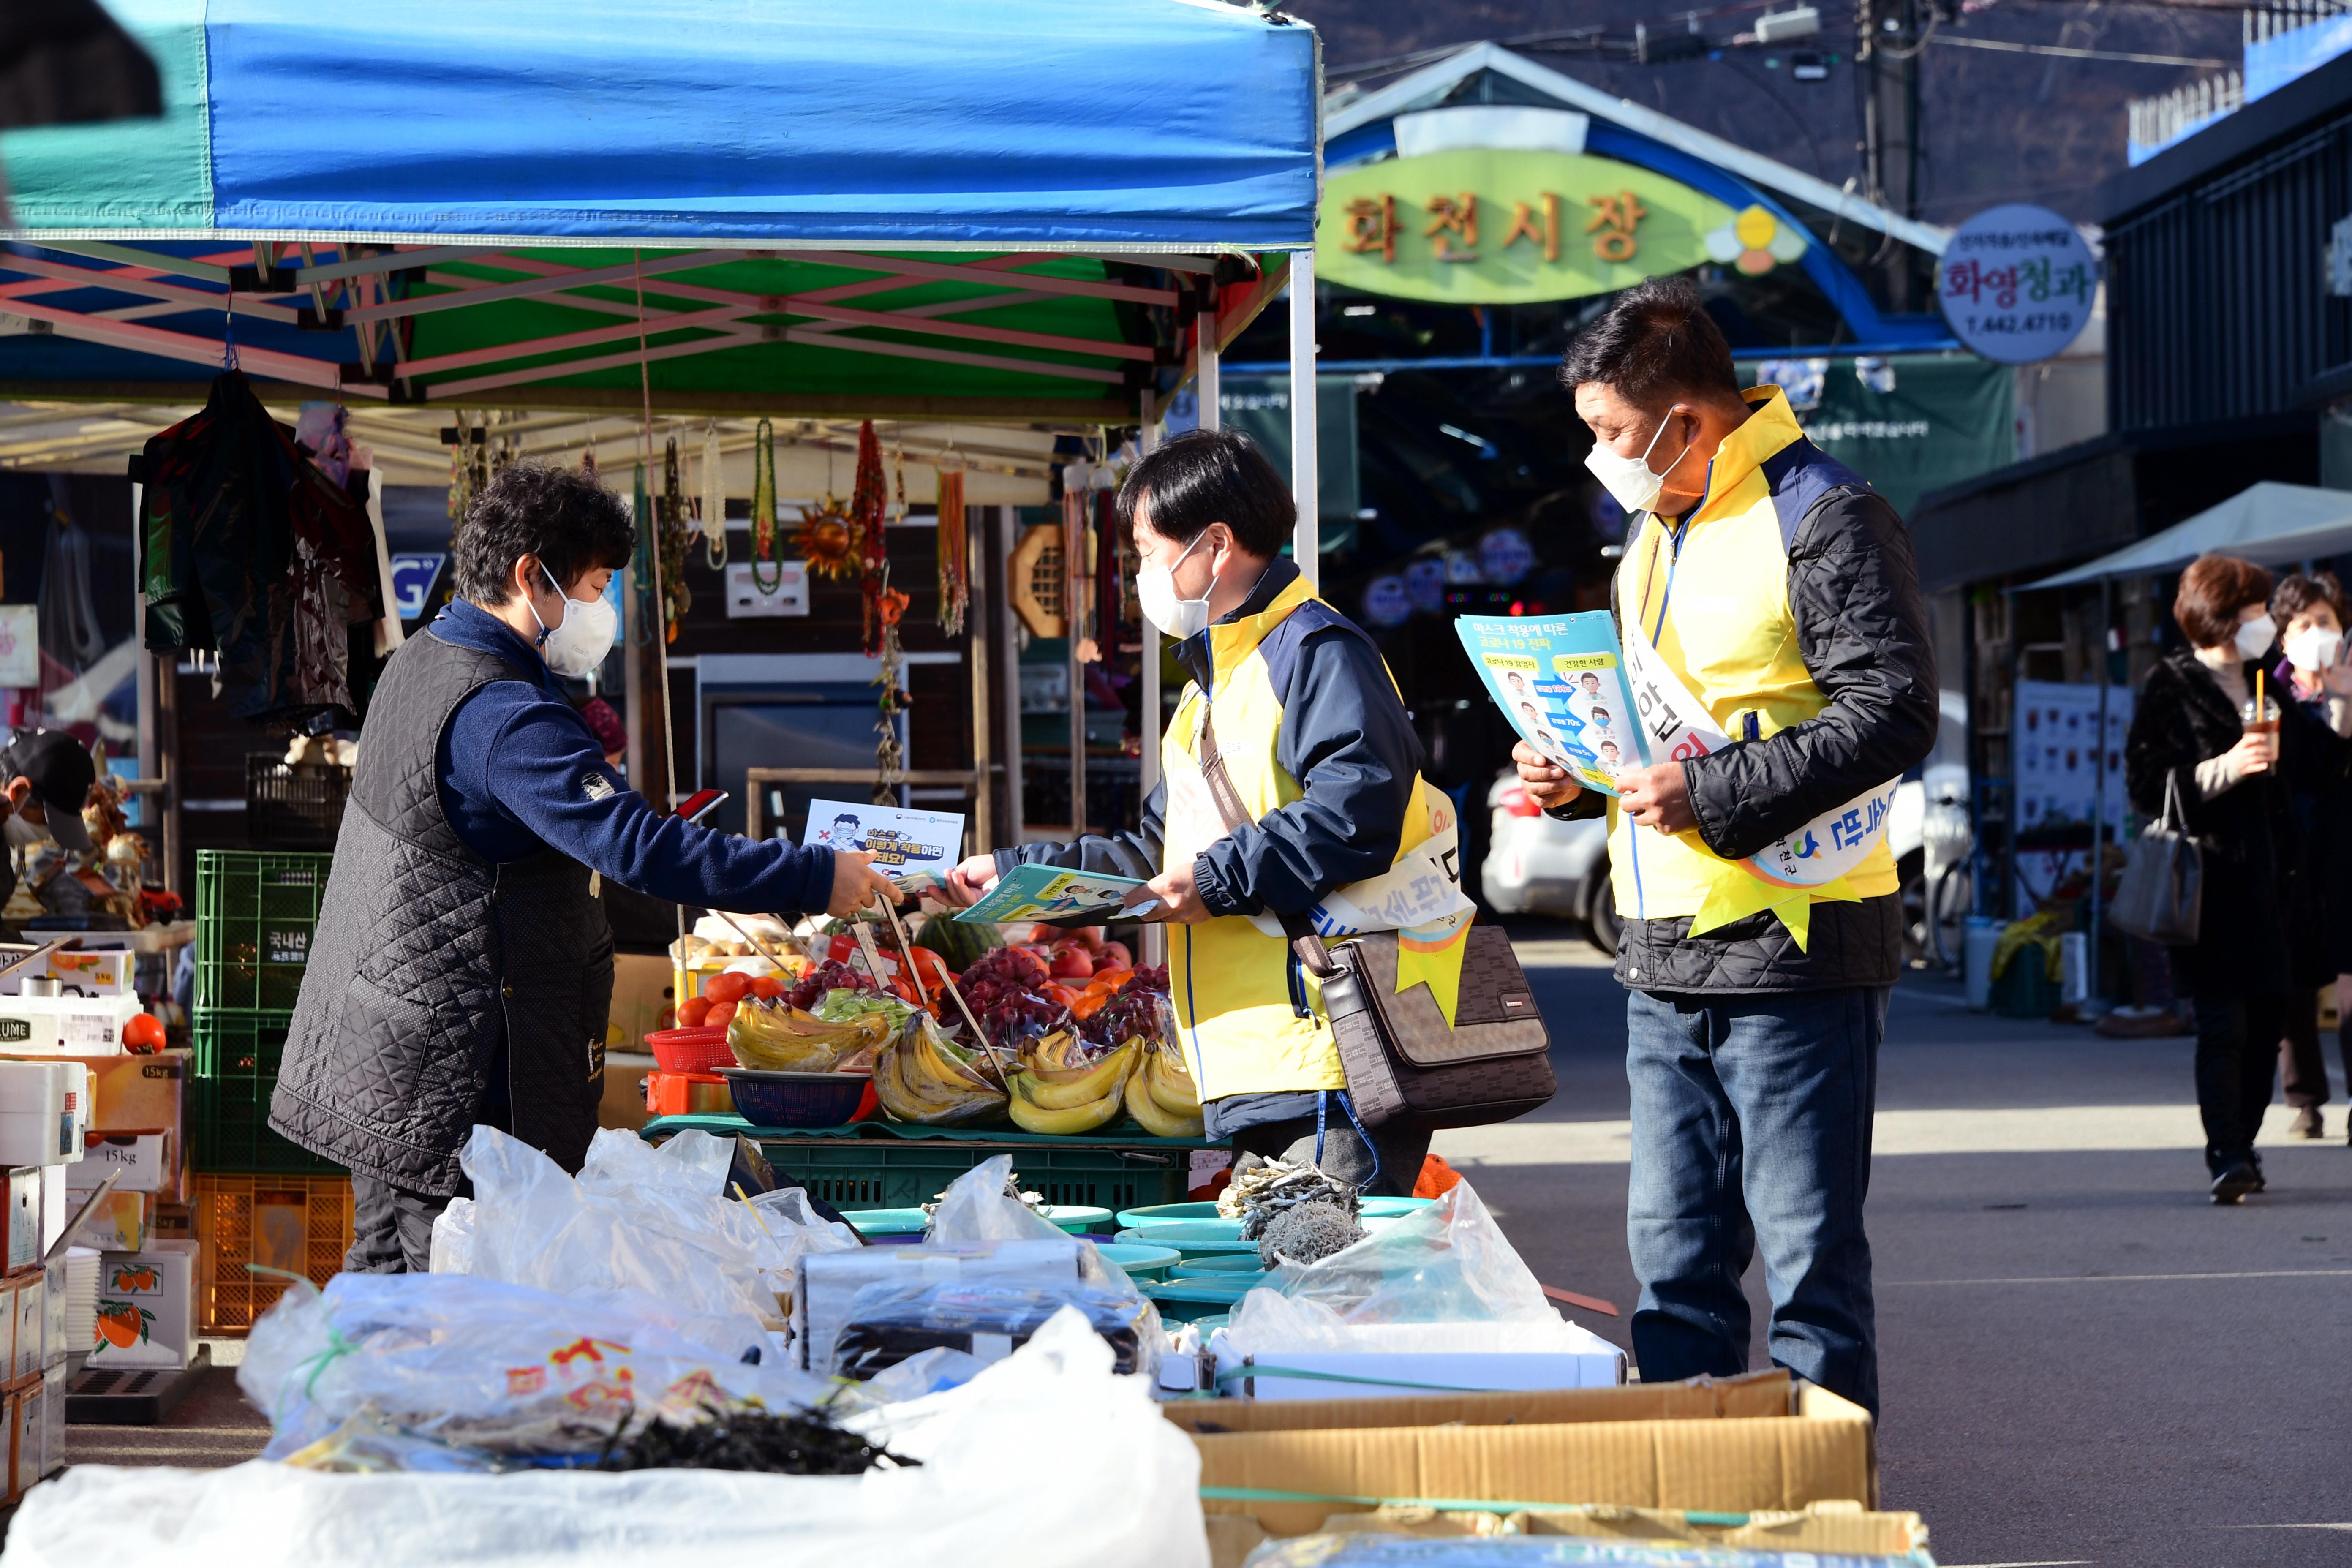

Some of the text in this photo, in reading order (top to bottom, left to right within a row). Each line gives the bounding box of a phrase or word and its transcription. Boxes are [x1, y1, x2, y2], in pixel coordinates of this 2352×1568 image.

[1342, 191, 1646, 263] 화천시장
[1946, 256, 2094, 309] 화영청과
[1473, 623, 1568, 637] 마스크 착용에 따른
[1478, 636, 1551, 650] 코로나 19 전파
[1485, 657, 1504, 665] 코로나
[1515, 660, 1535, 668] 감염자
[1565, 658, 1604, 668] 건강한 사람
[1552, 685, 1573, 693] 100%
[868, 829, 896, 839] 마스크
[866, 839, 944, 857] 이렇게 착용하면
[1044, 883, 1061, 896] 건강한
[270, 931, 307, 950] 국내산
[0, 1022, 26, 1037] UME
[144, 1068, 169, 1078] 15kg
[105, 1149, 136, 1165] 15kg
